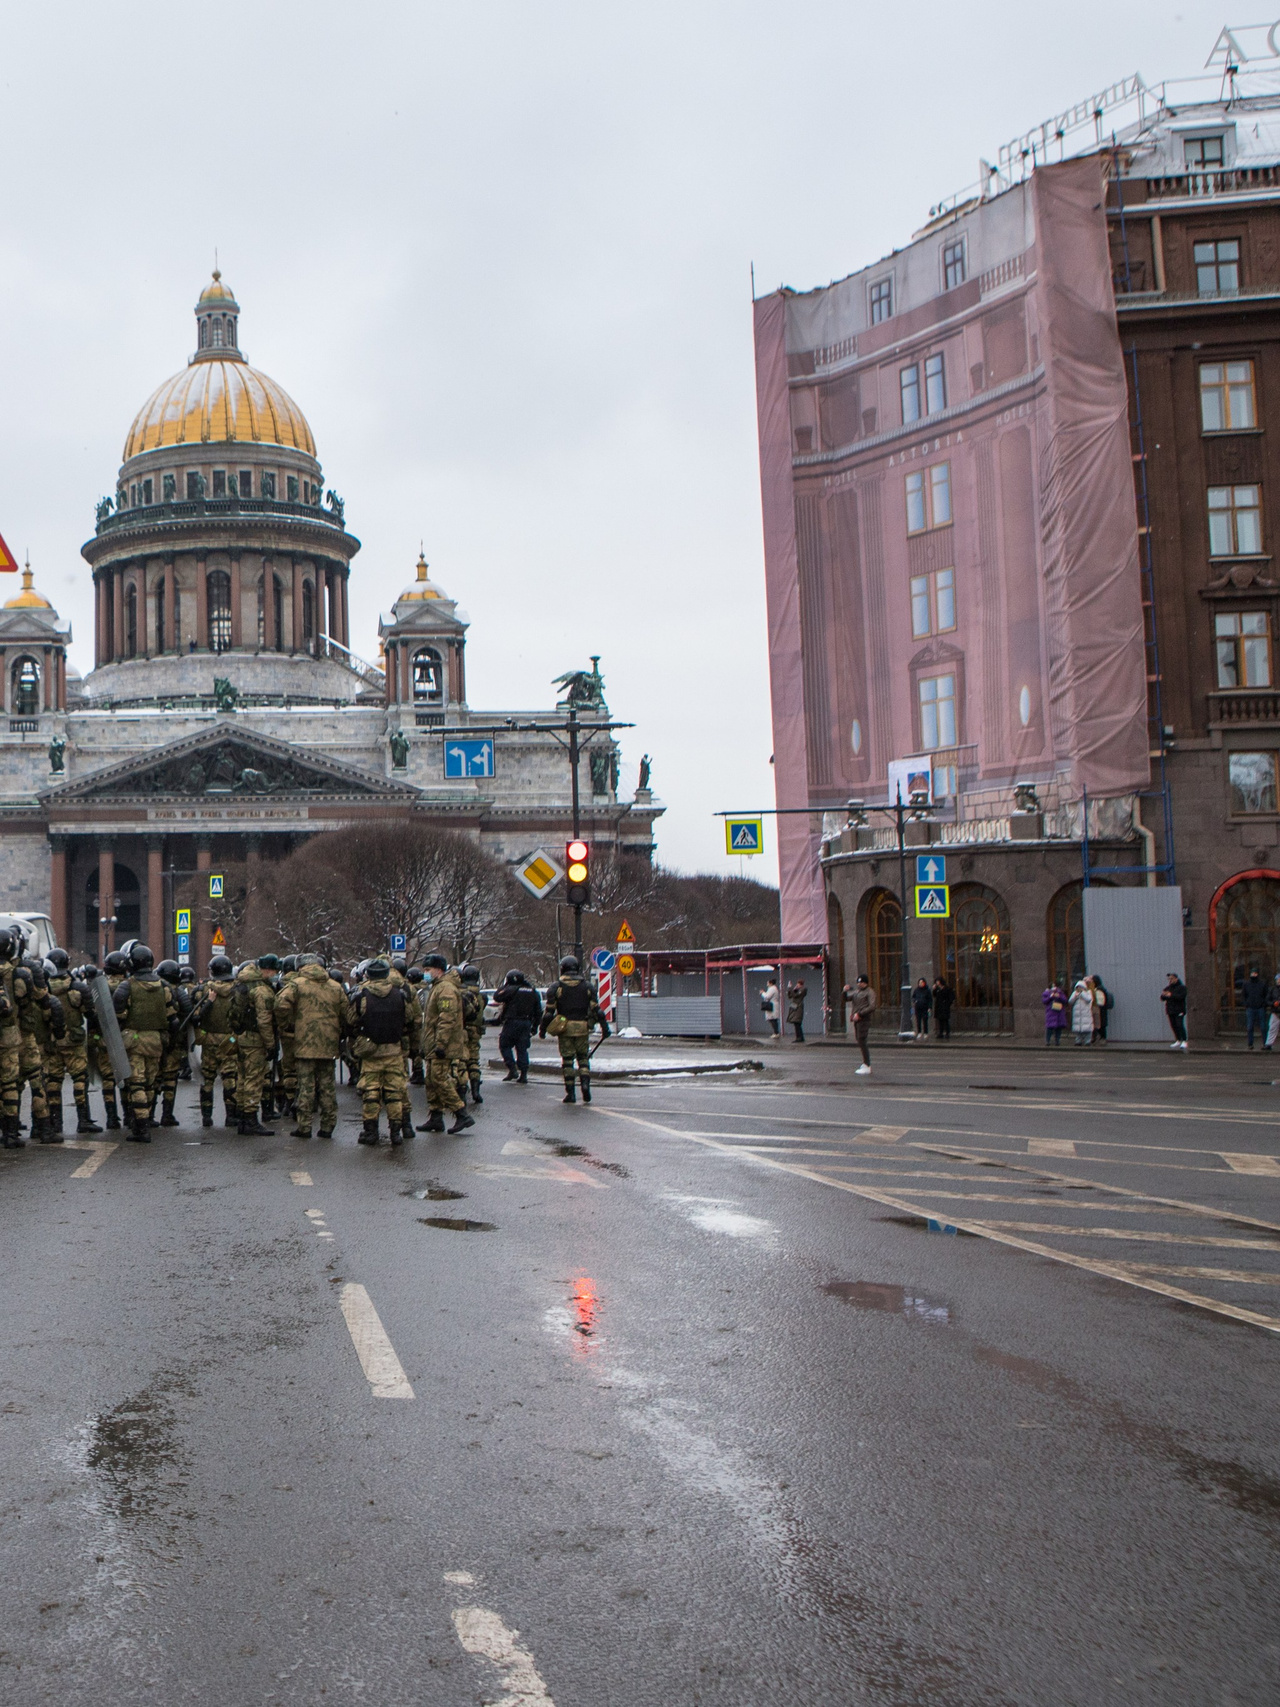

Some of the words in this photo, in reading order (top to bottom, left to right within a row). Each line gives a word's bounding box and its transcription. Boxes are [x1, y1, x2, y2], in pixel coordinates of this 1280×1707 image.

[824, 470, 858, 487] HOTEL
[888, 431, 964, 467] ASTORIA
[995, 405, 1032, 427] HOTEL
[180, 936, 187, 951] P
[394, 936, 404, 949] P
[621, 960, 632, 969] 40
